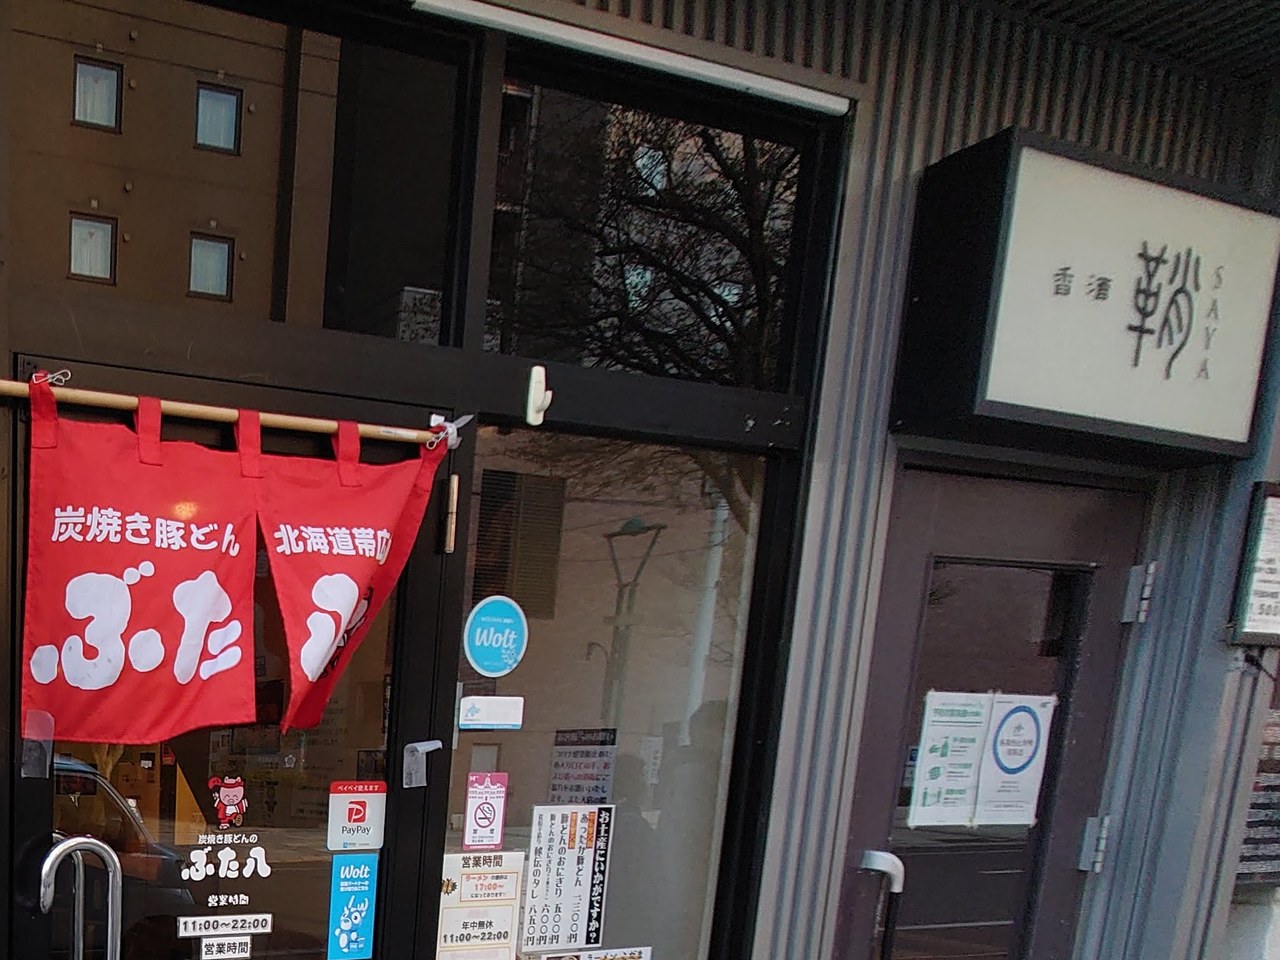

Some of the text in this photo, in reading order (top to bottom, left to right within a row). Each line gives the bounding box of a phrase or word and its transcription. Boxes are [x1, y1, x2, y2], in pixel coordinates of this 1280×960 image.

[1195, 265, 1226, 380] SAYA
[51, 506, 240, 557] 炭焼き豚どん
[475, 627, 518, 649] Wolt
[337, 784, 379, 792] ペイペイ使えます
[341, 825, 371, 835] PayPay
[198, 833, 258, 845] 炭焼き豚どんの
[181, 846, 271, 881] ぶた八
[461, 855, 503, 868] 営業時間
[340, 864, 370, 879] Wolt
[462, 920, 494, 930] 年中無休
[204, 942, 249, 955] 営業時間
